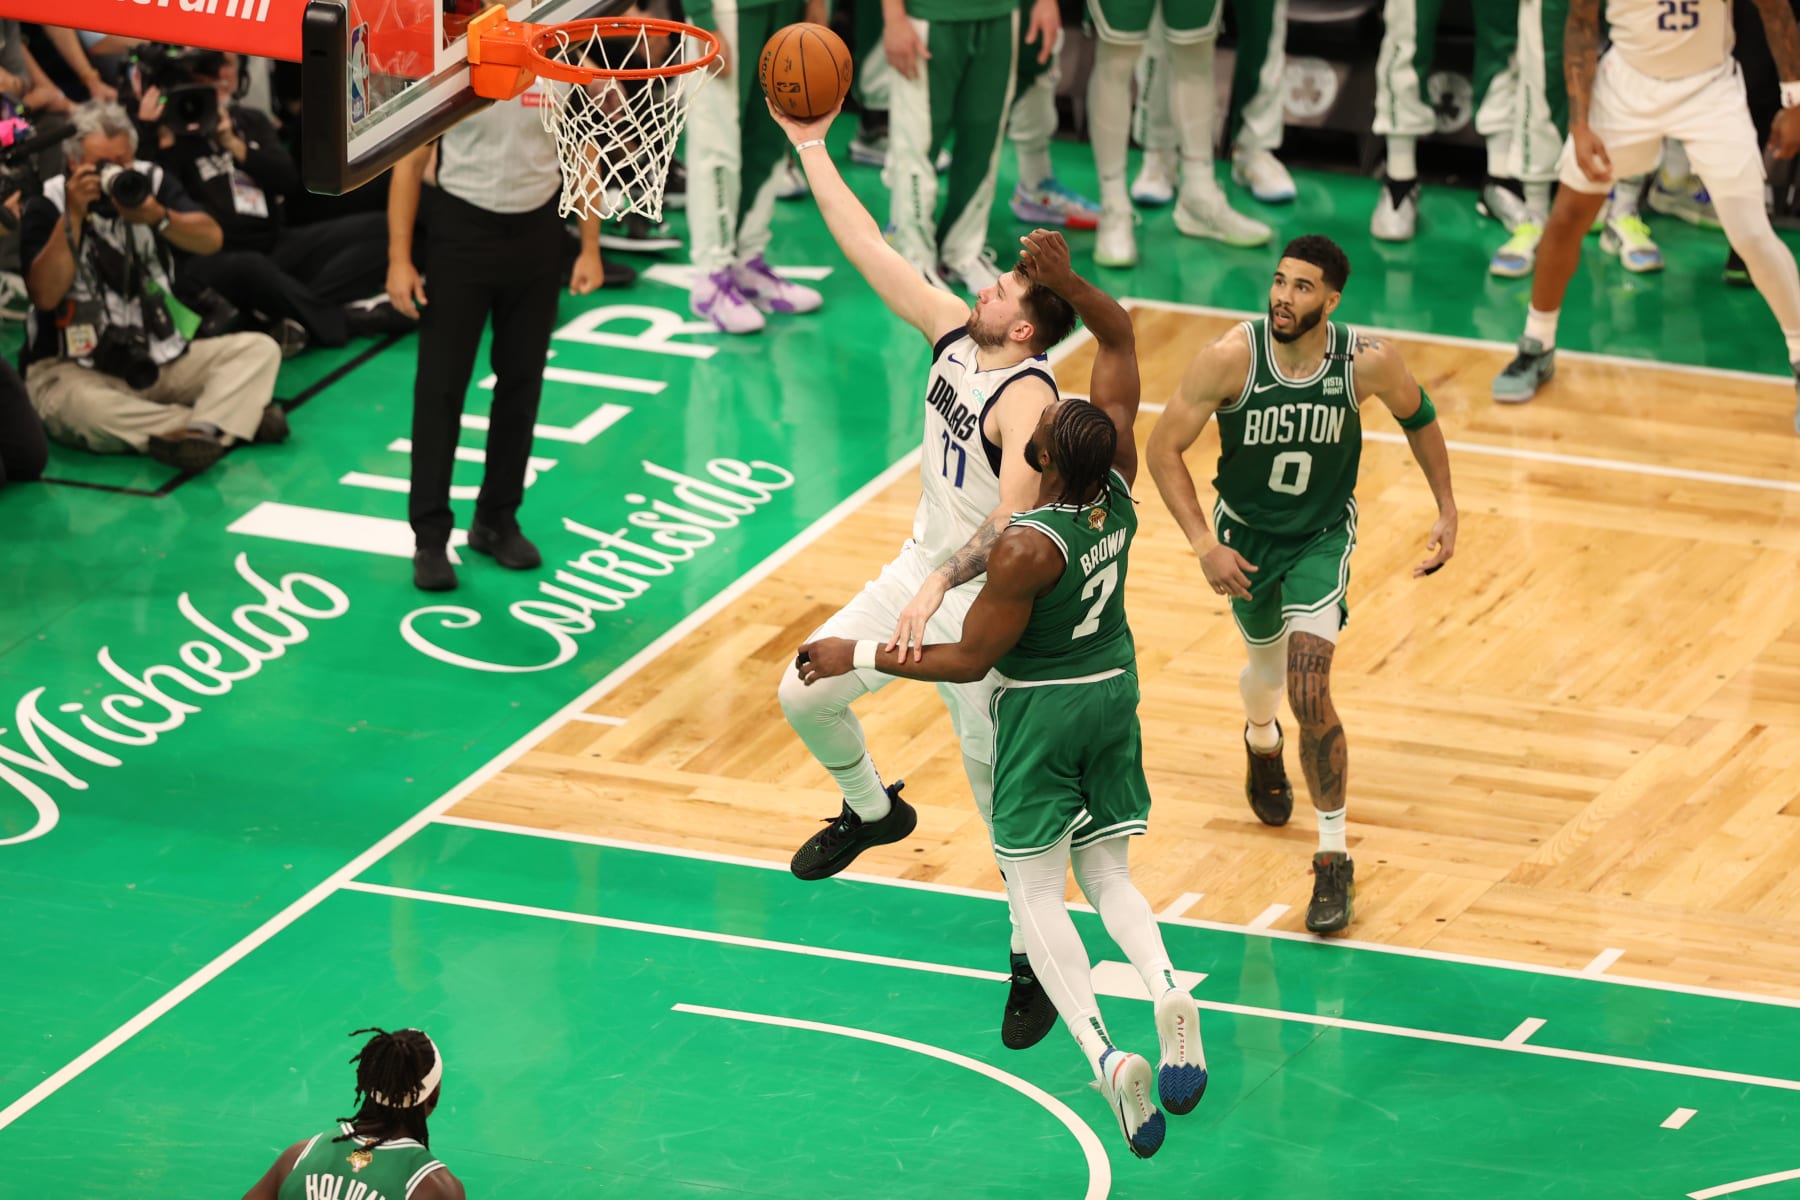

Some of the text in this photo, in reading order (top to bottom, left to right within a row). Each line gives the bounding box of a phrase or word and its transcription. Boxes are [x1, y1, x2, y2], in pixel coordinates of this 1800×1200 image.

[1657, 0, 1699, 31] 25
[1323, 377, 1343, 387] VISTA
[1323, 387, 1343, 396] PRINT
[1243, 402, 1346, 446] BOSTON
[942, 429, 966, 489] 77
[1267, 451, 1313, 496] 0
[401, 457, 795, 673] Courtside
[1079, 527, 1127, 577] BROWN
[1071, 559, 1119, 640] 7
[0, 553, 351, 846] Michelob
